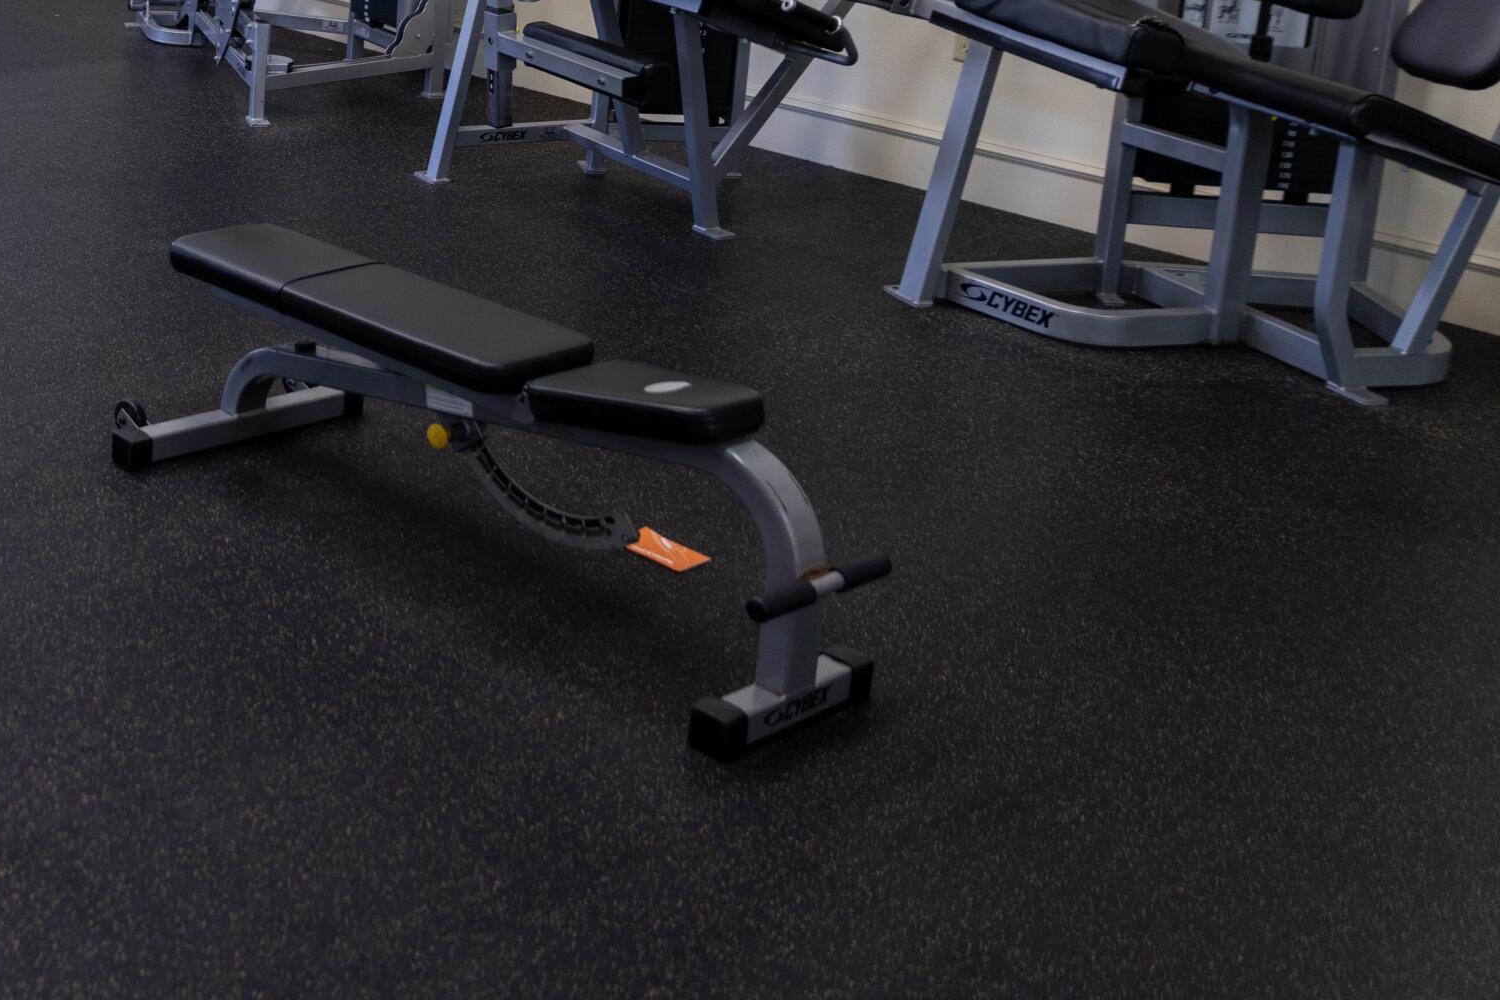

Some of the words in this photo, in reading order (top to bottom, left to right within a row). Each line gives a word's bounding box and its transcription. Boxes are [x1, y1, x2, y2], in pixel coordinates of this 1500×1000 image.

[494, 130, 528, 141] CYBEX
[986, 291, 1055, 328] CYBEX
[785, 685, 831, 719] CYBEX
